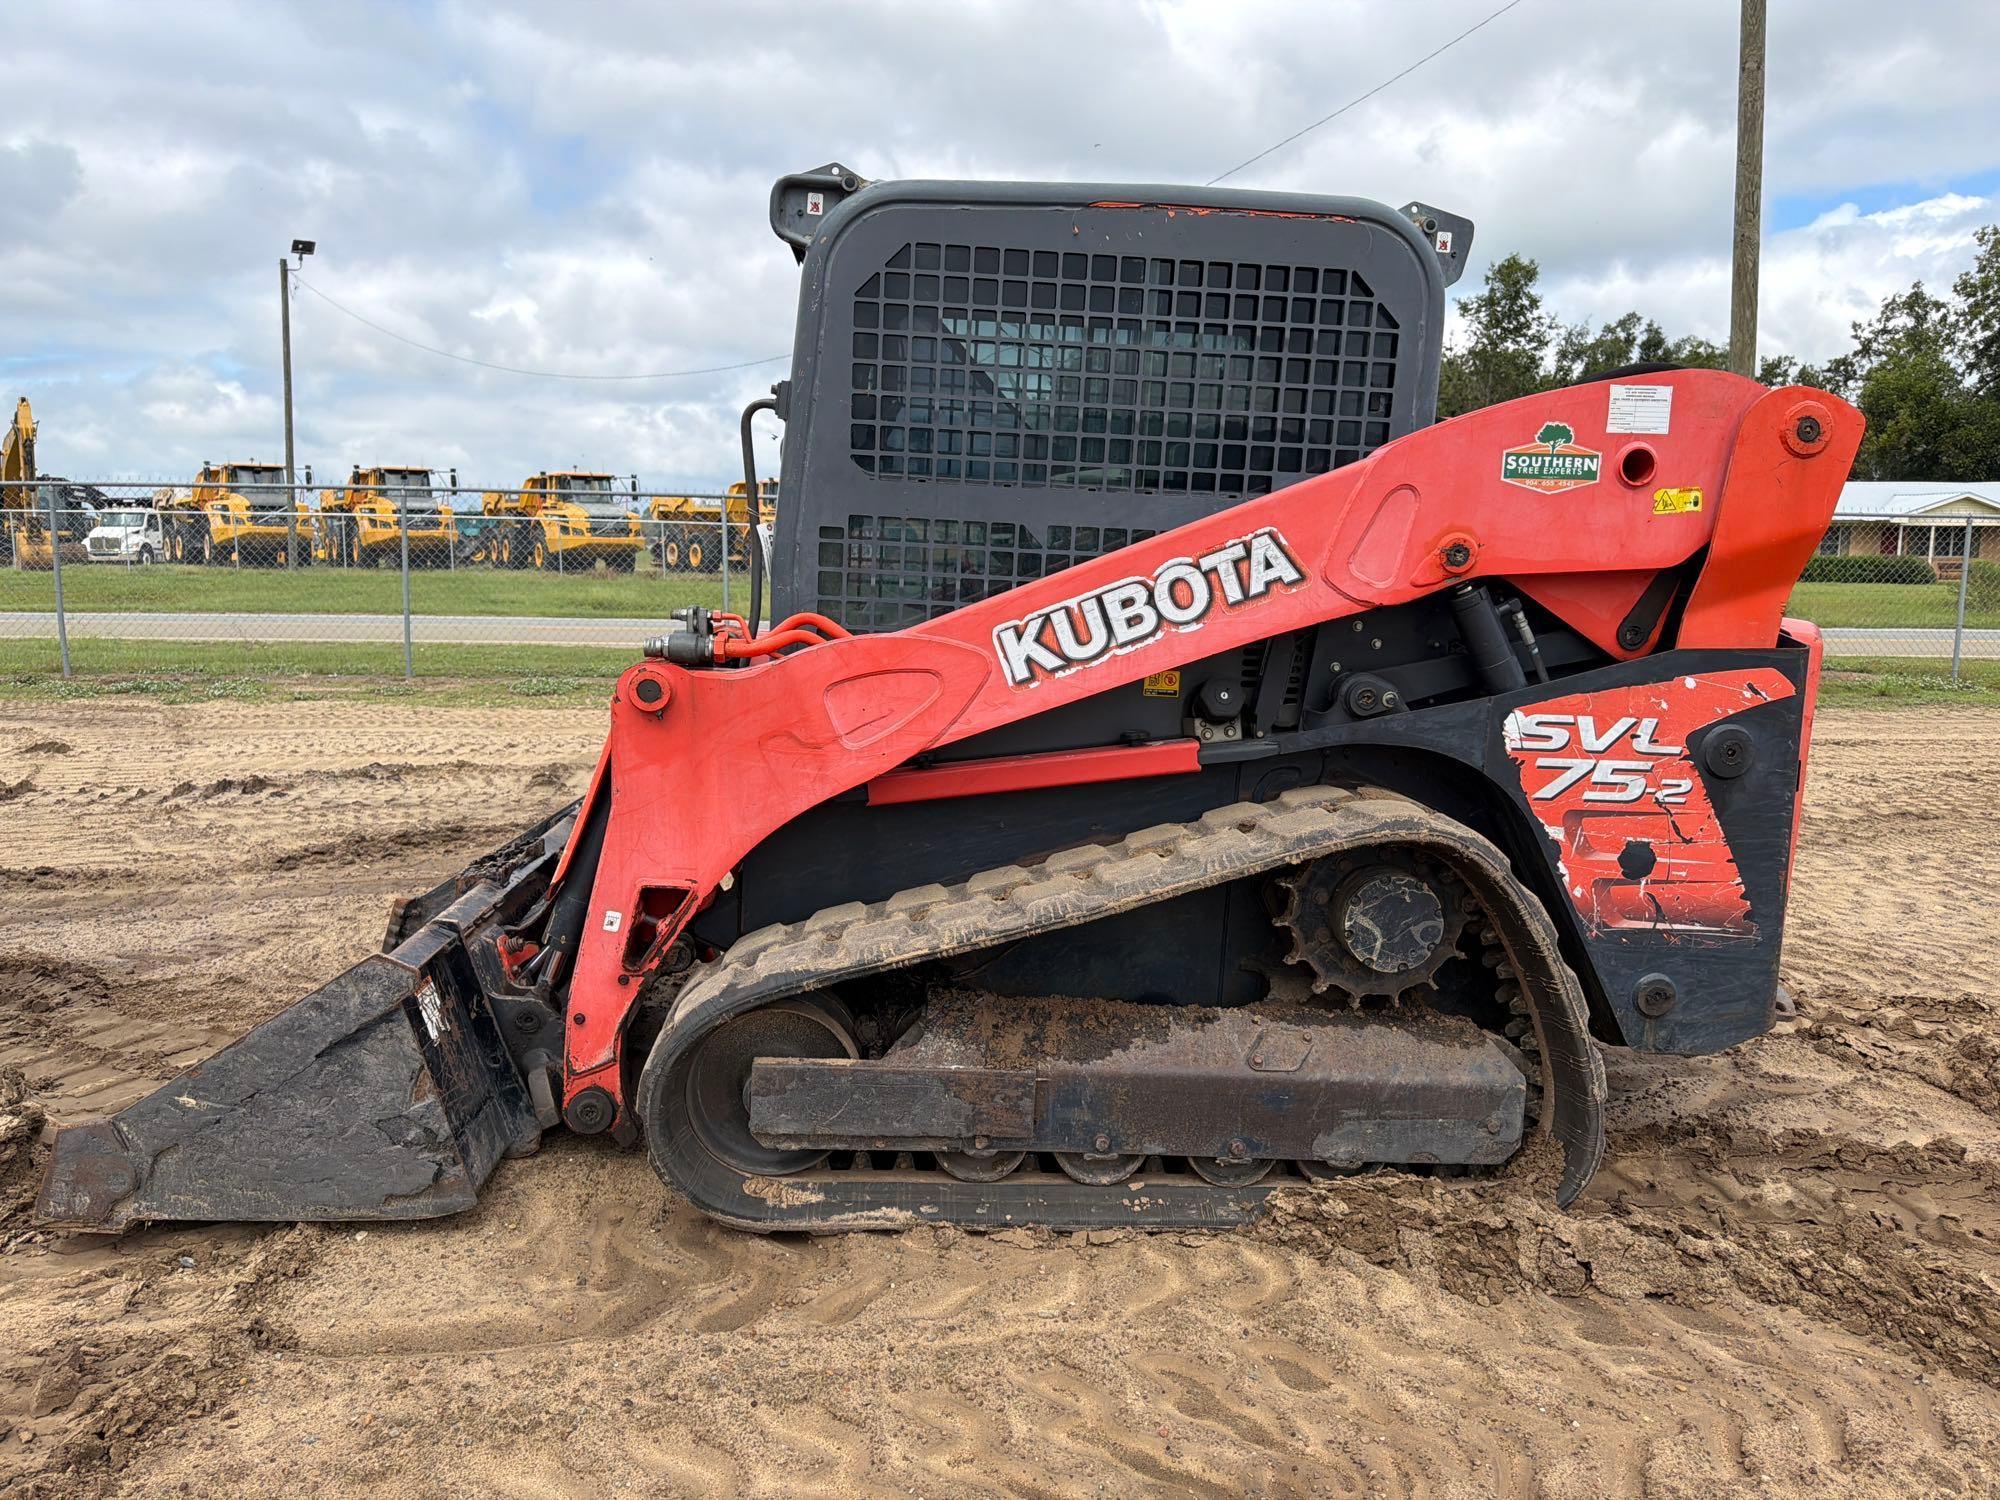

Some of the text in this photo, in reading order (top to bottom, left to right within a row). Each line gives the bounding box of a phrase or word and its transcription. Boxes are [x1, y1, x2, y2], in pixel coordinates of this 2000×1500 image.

[1506, 455, 1598, 471] SOUTHERN
[1517, 466, 1583, 476] TREE EXPERTS
[997, 531, 1302, 684] KUBOTA
[1506, 713, 1684, 755] SVL
[1531, 756, 1693, 804] 75-2
